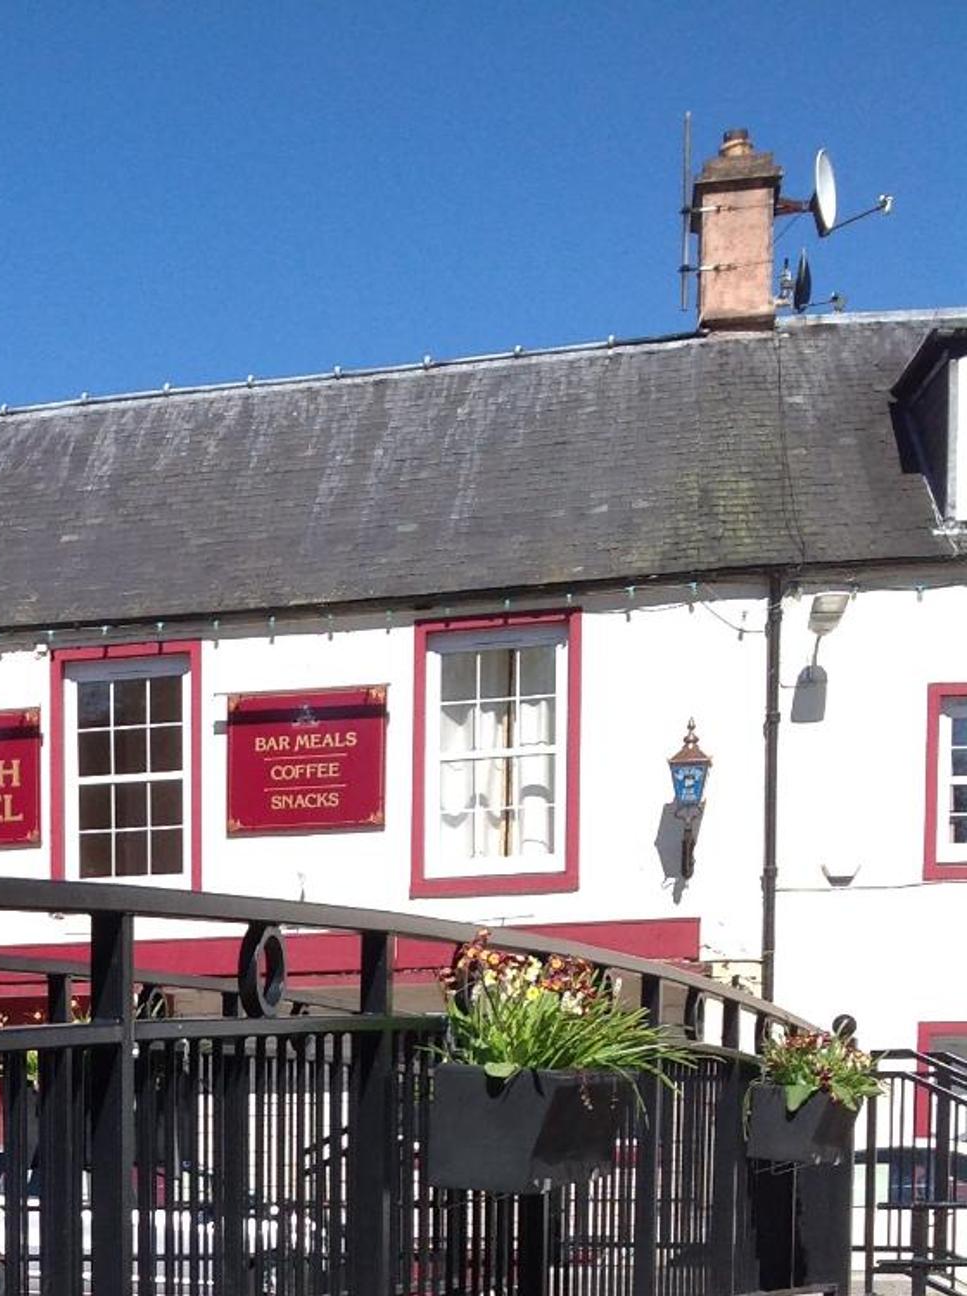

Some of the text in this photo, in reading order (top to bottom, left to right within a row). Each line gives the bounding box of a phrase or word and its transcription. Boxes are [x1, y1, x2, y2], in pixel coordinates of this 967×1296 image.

[255, 731, 358, 751] BAR MEALS
[270, 762, 340, 780] COFFEE
[271, 792, 339, 810] SNACKS
